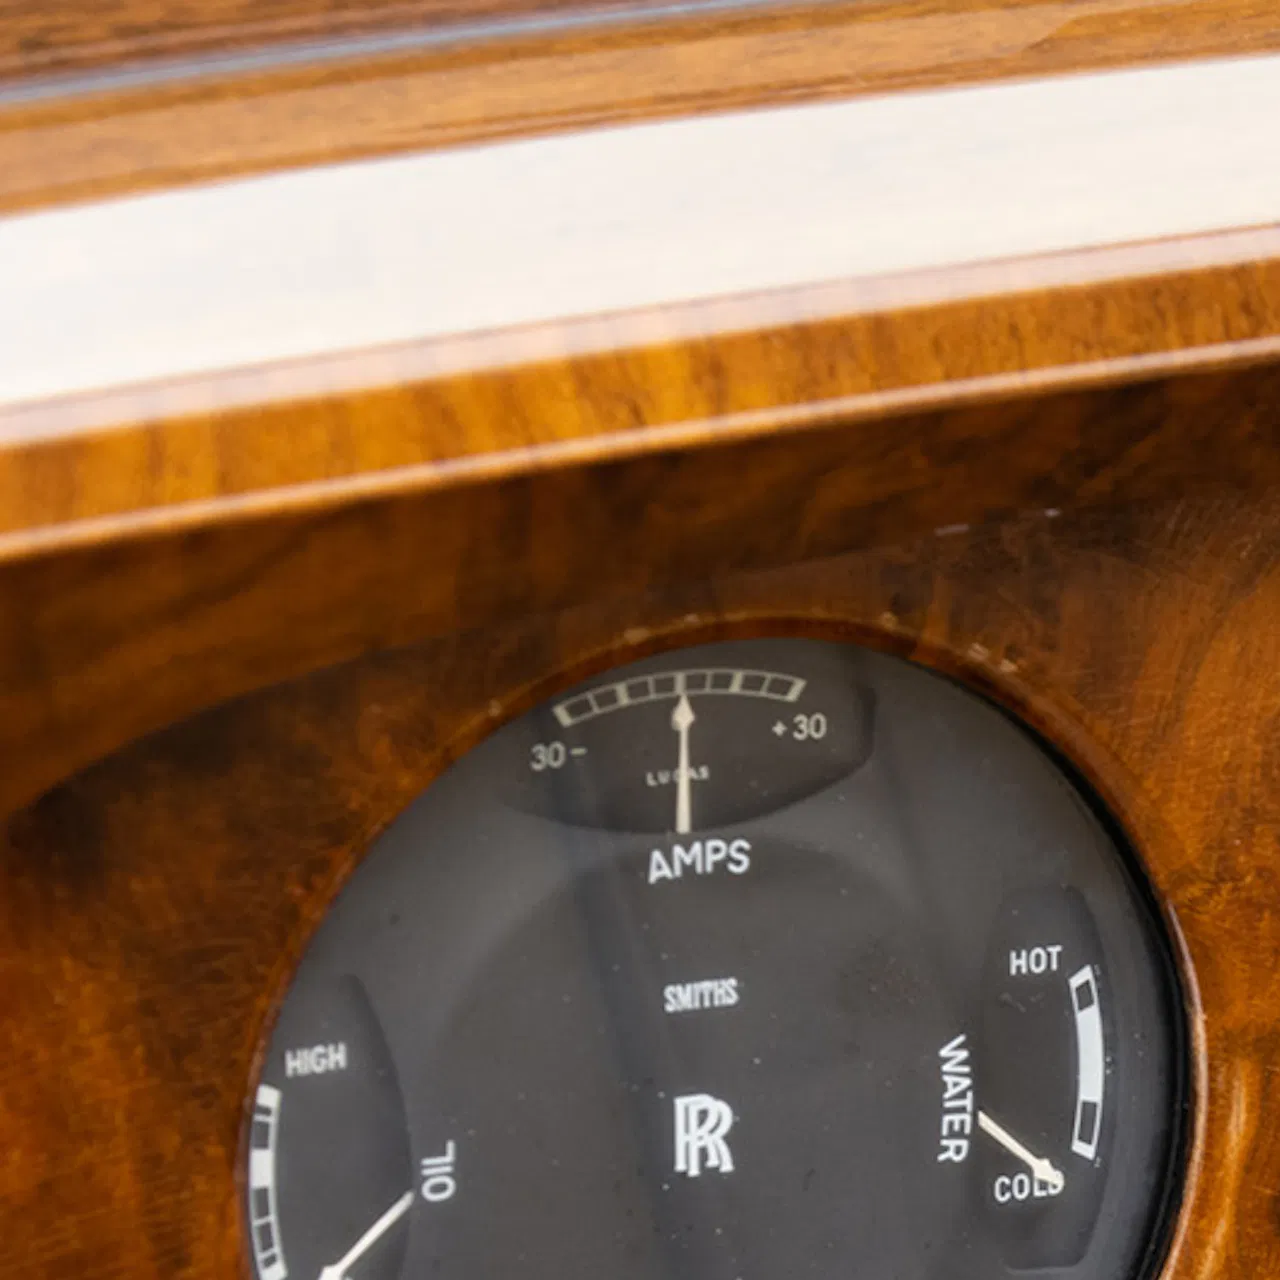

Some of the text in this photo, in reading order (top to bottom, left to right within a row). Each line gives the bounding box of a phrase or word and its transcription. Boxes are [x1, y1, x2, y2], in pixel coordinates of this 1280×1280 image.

[772, 713, 827, 741] +30
[648, 839, 752, 884] AMPS
[1009, 945, 1063, 976] HOT
[664, 977, 740, 1013] SMITHS
[284, 1042, 348, 1078] HIGH
[938, 1034, 973, 1163] WATER
[420, 1140, 456, 1201] OIL
